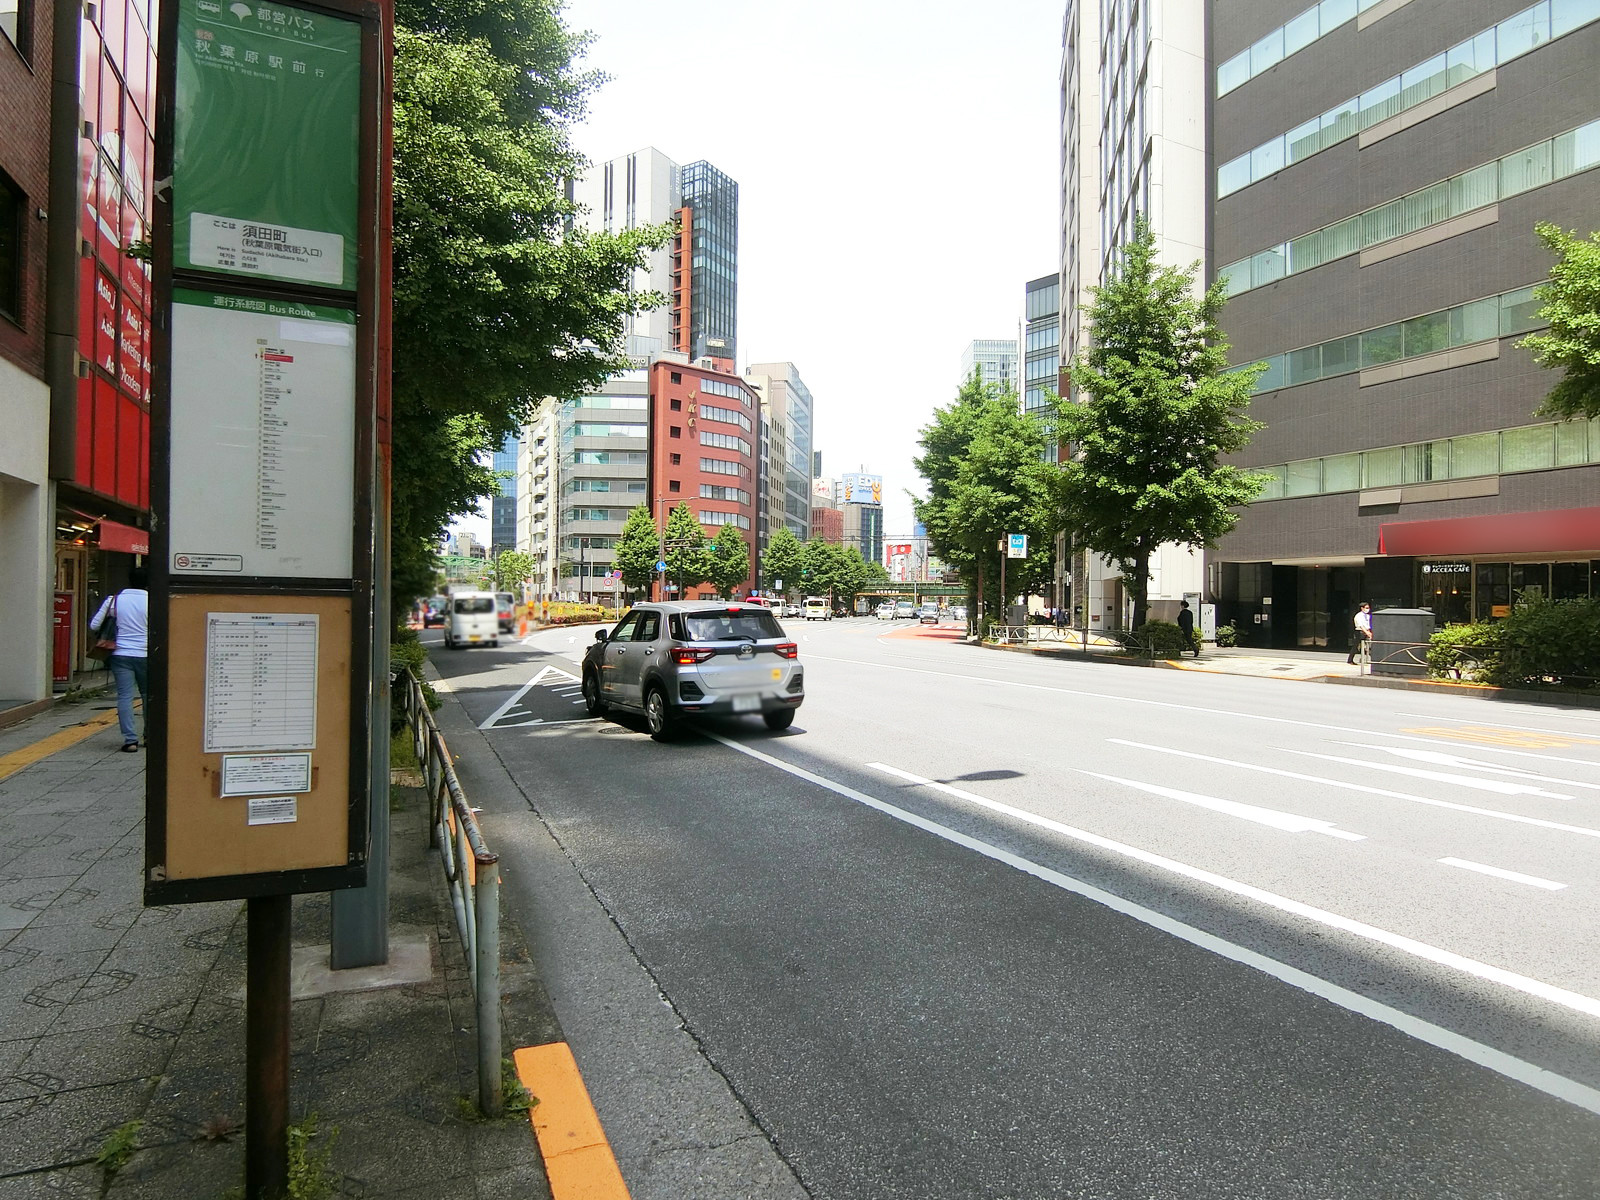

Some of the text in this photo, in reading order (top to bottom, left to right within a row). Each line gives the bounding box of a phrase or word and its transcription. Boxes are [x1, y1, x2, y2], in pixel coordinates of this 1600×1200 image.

[257, 8, 315, 32] 都営バス
[259, 22, 315, 41] Toei Bus
[213, 220, 288, 243] ここは 須田町
[241, 238, 323, 258] (秋葉原電気街入口)
[98, 278, 111, 304] Asia
[213, 295, 266, 311] 運行系統図
[269, 303, 316, 317] Bus Route
